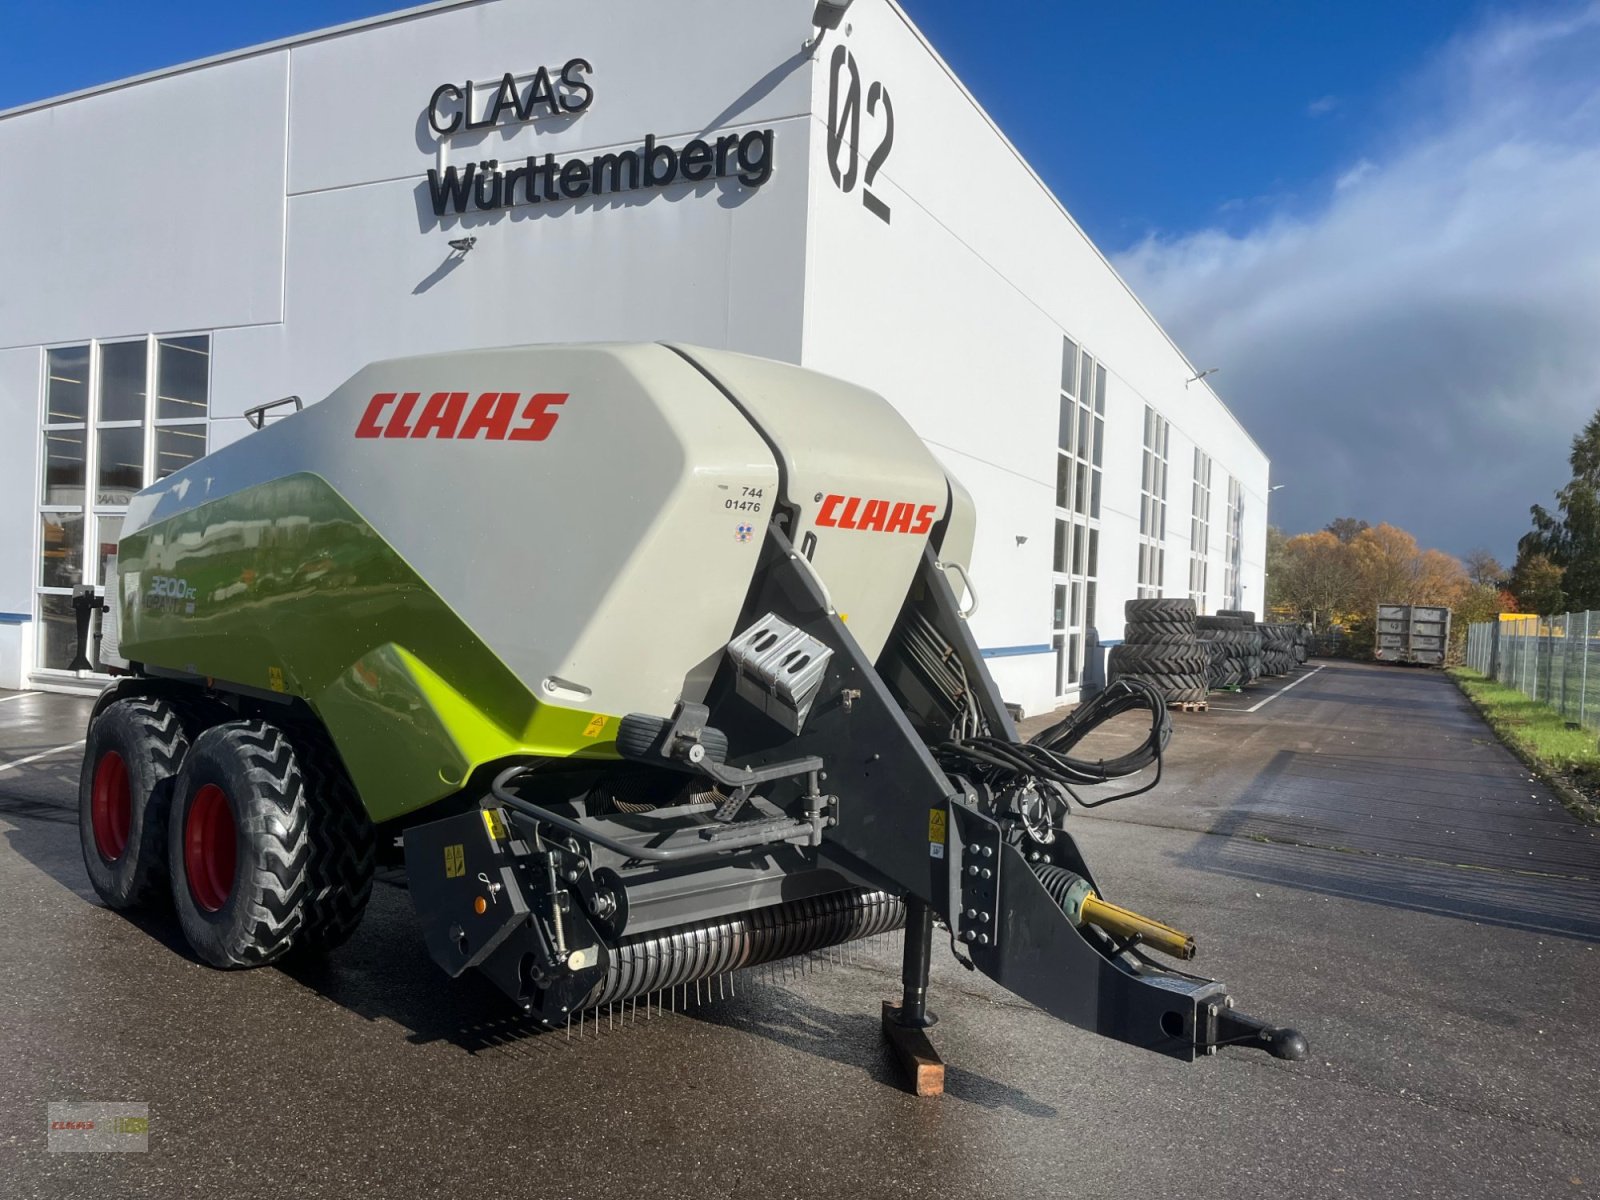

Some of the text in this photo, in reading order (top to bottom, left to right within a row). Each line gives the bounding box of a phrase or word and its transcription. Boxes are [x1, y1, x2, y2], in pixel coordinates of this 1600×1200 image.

[428, 57, 594, 134] CLAAS
[427, 128, 774, 216] Württemberg
[354, 392, 570, 441] CLAAS
[725, 499, 761, 512] 01476
[742, 486, 763, 498] 744
[815, 494, 936, 534] CLAAS
